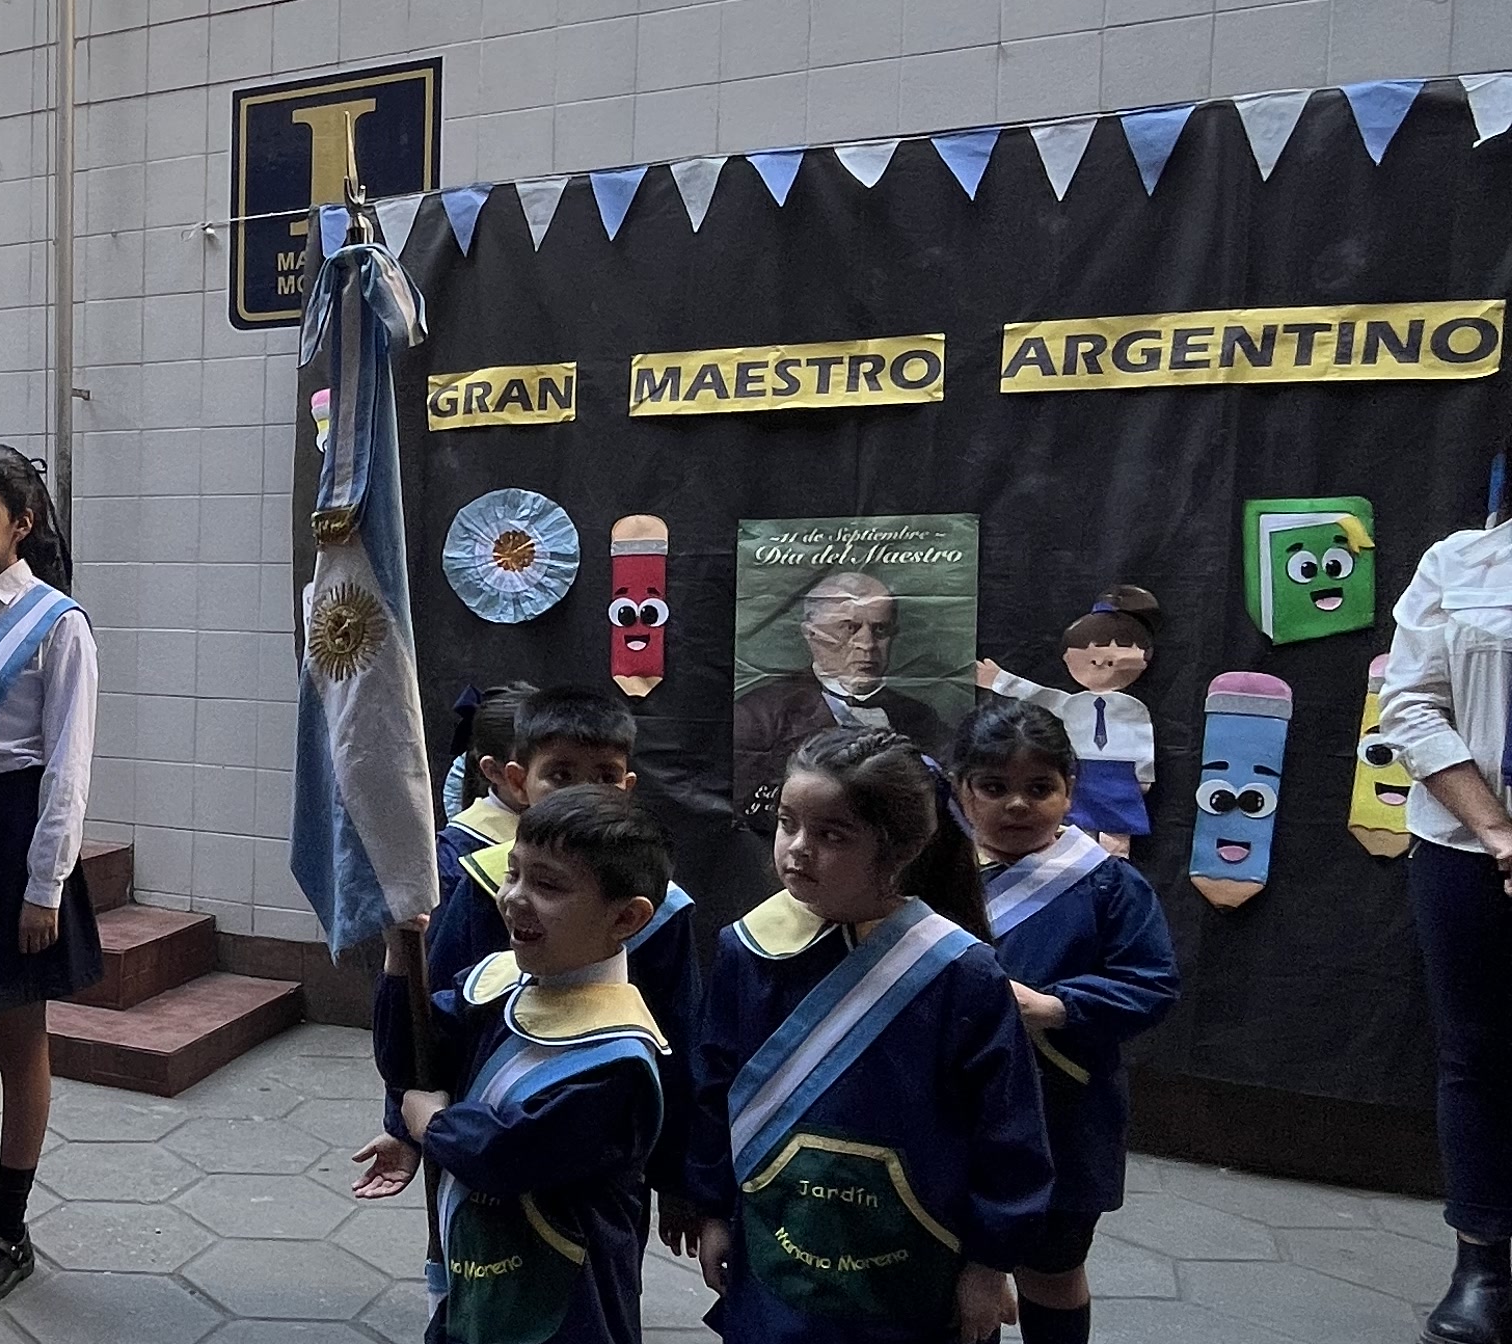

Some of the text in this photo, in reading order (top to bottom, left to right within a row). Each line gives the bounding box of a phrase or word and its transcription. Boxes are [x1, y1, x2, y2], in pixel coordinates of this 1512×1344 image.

[429, 316, 1499, 418] GRAN MAESTRO ARGENTINO
[803, 528, 825, 543] de
[828, 525, 930, 545] Septiembre
[811, 543, 854, 565] del
[851, 543, 963, 567] Maestro
[799, 1180, 878, 1207] Jardín
[463, 1255, 523, 1282] Moreno
